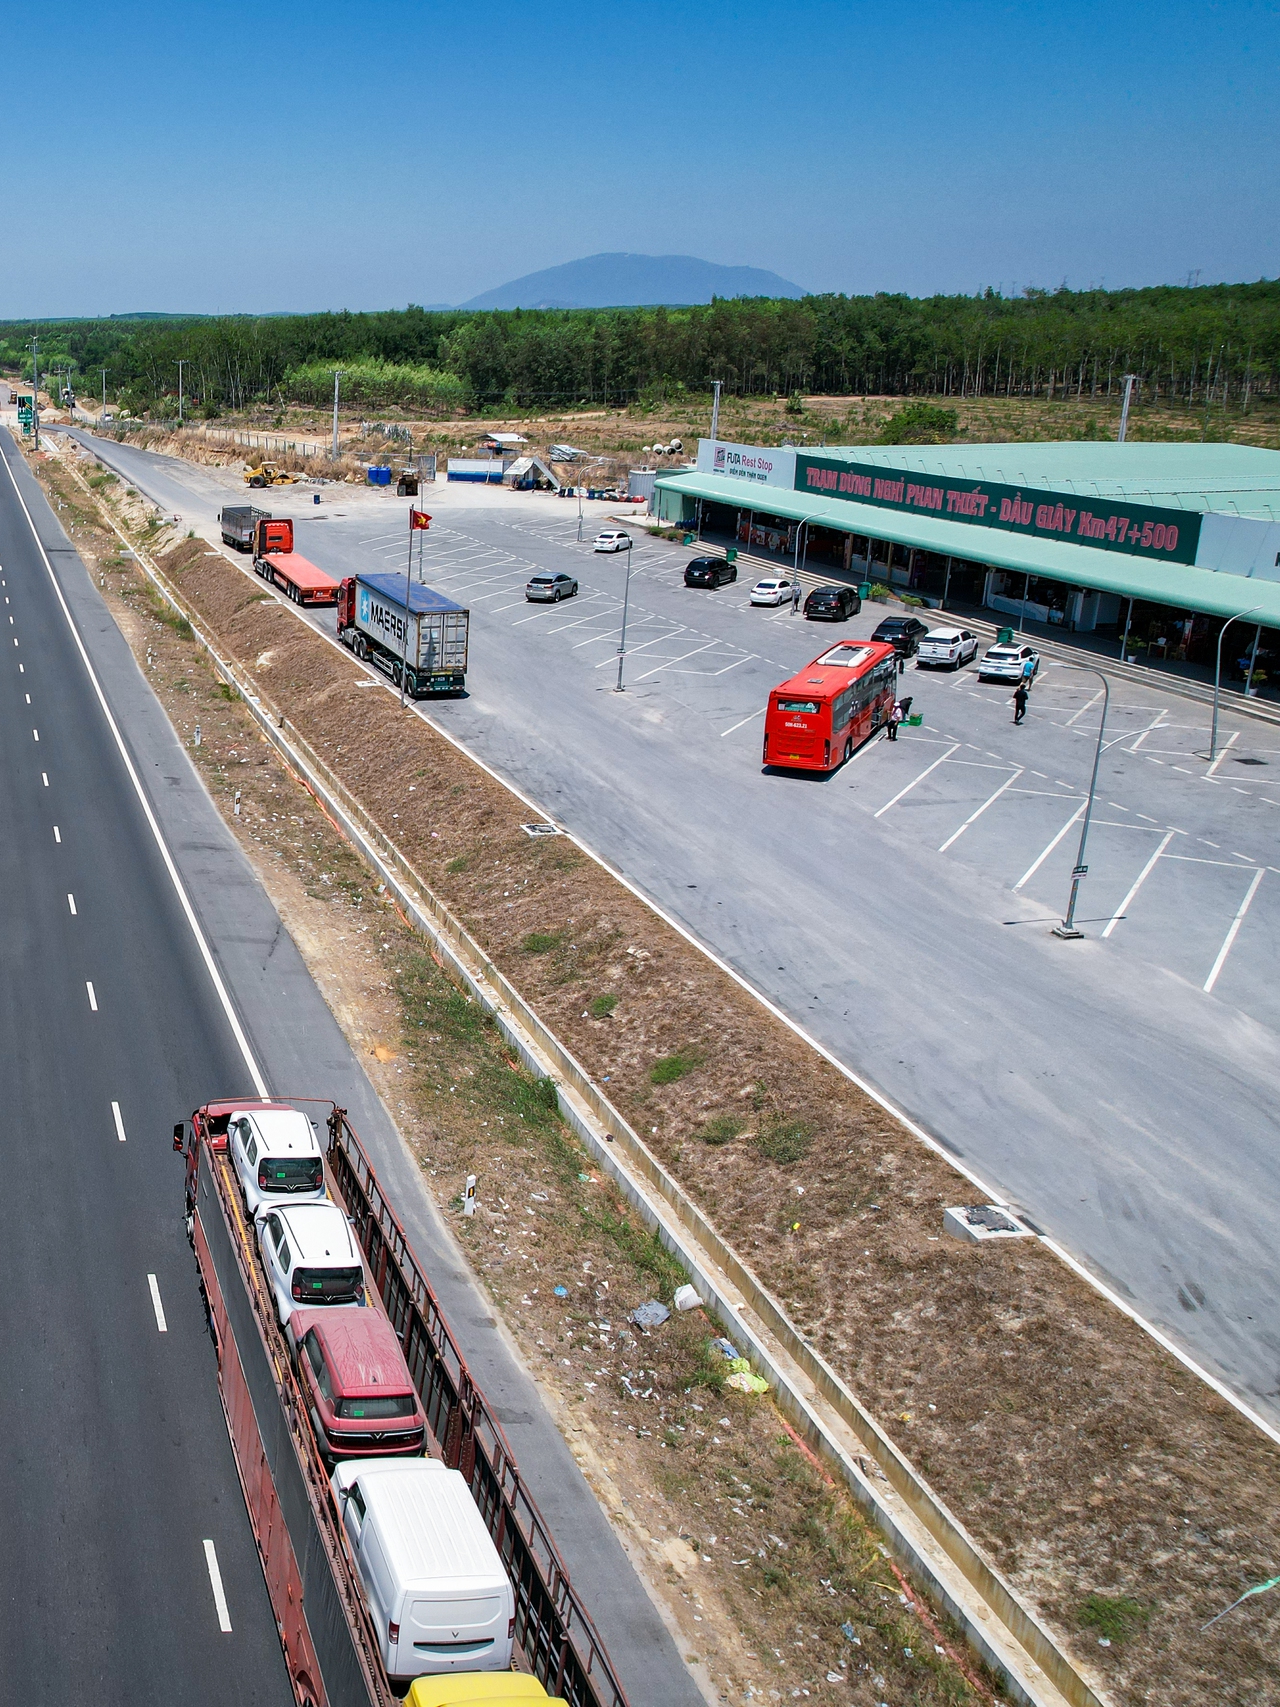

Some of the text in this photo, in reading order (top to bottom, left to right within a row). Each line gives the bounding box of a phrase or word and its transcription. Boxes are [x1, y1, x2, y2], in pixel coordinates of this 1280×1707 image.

[727, 452, 741, 465] FUTA
[742, 455, 756, 468] Rest
[758, 458, 773, 473] Stop
[806, 467, 838, 492] TRẠM
[838, 470, 872, 496] DỪNG
[873, 477, 905, 503] NGHỈ
[905, 483, 944, 510] PHAN
[946, 485, 989, 517] THIẾT
[999, 491, 1034, 525] DẦU
[1035, 502, 1076, 533] GIÂY
[1077, 511, 1179, 551] Km47+500
